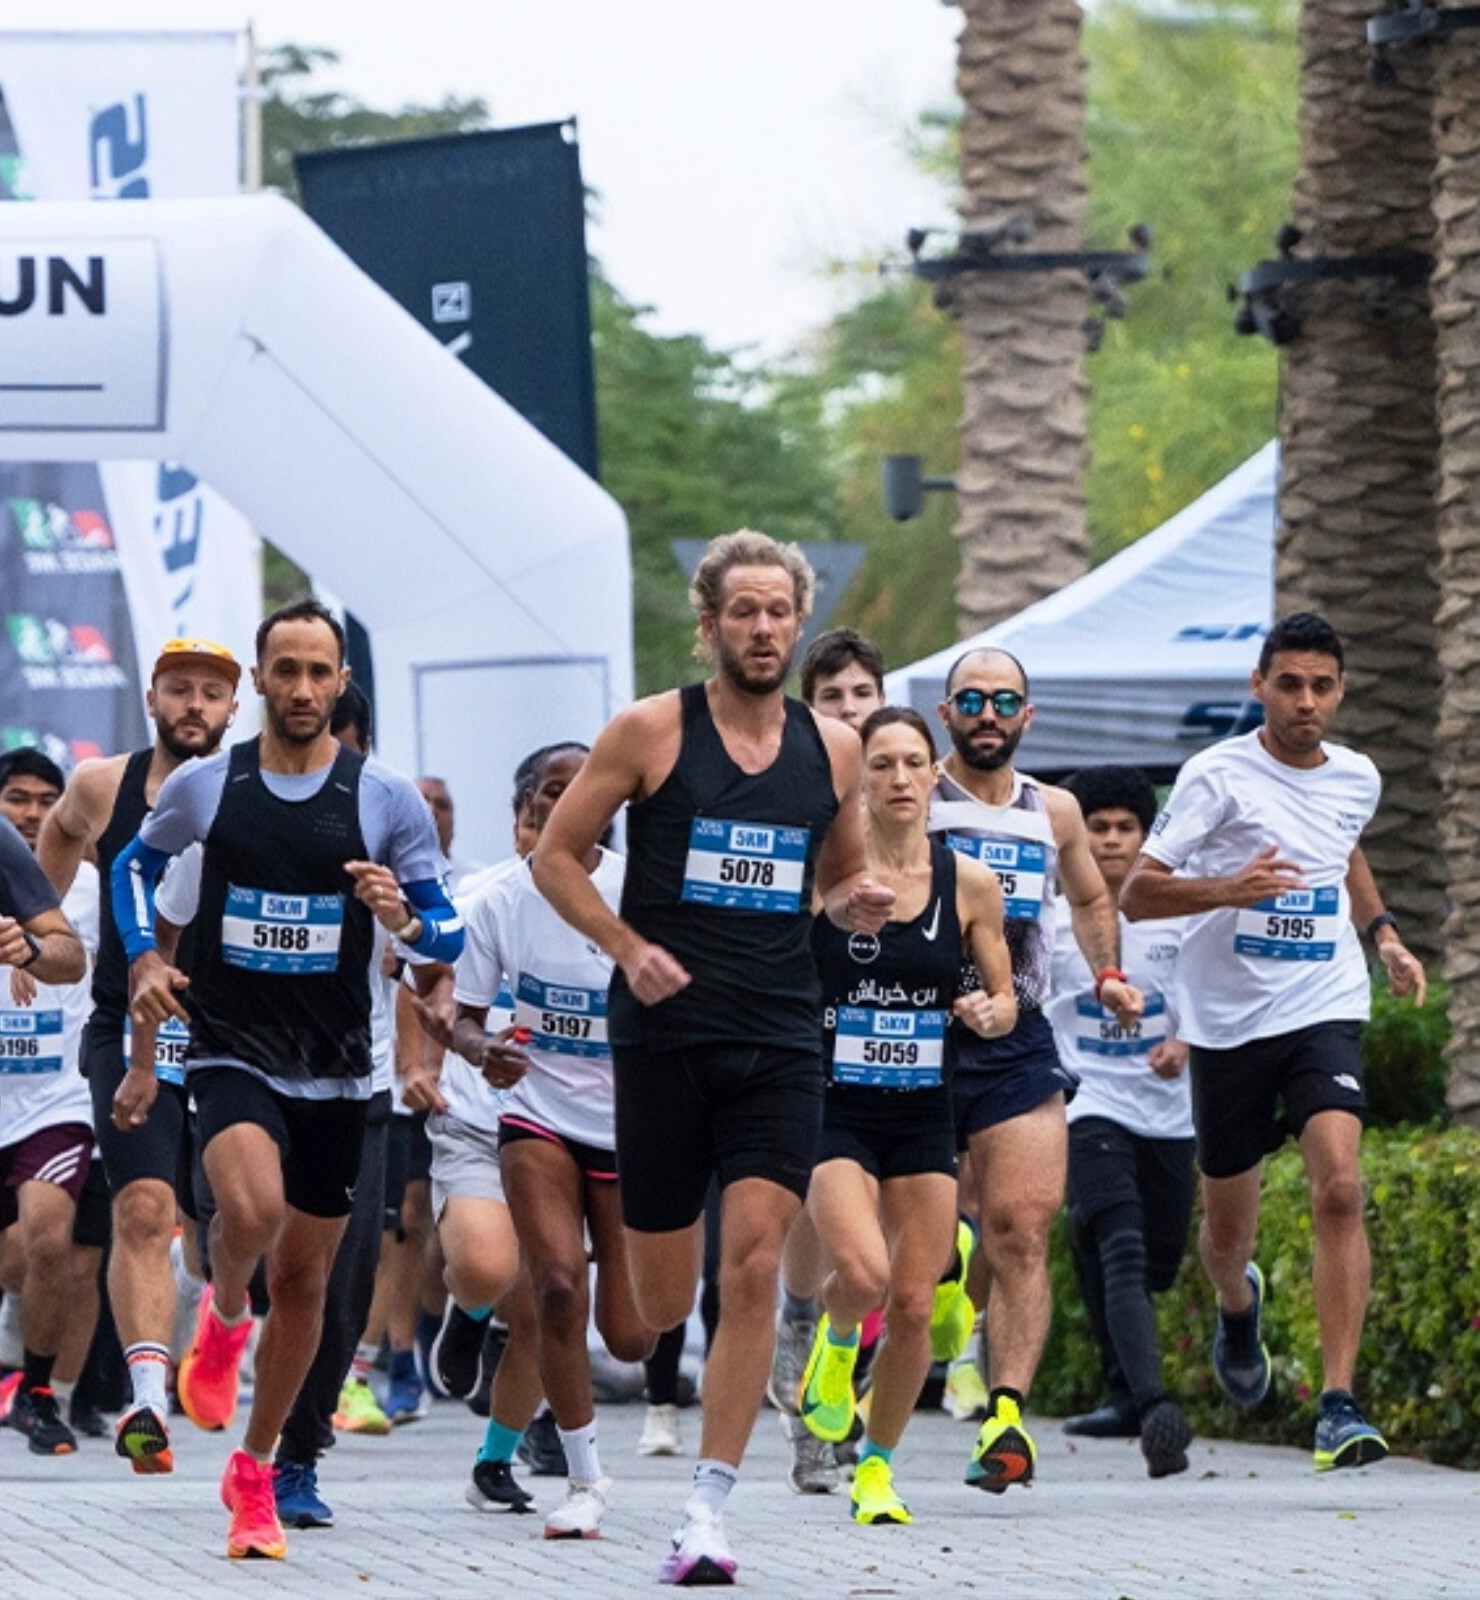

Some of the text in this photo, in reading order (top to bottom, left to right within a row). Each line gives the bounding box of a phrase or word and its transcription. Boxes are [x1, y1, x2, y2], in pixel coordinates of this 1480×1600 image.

[735, 830, 769, 849] 5KM
[983, 845, 1015, 861] 5KM
[720, 858, 775, 886] 5078
[267, 898, 302, 916] 5KM
[1267, 916, 1315, 938] 5195
[253, 924, 310, 951] 5188
[551, 991, 583, 1006] 5KM
[4, 1018, 30, 1028] 5KM
[542, 1013, 591, 1038] 5197
[879, 1015, 910, 1031] 5KM
[863, 1040, 919, 1064] 5059
